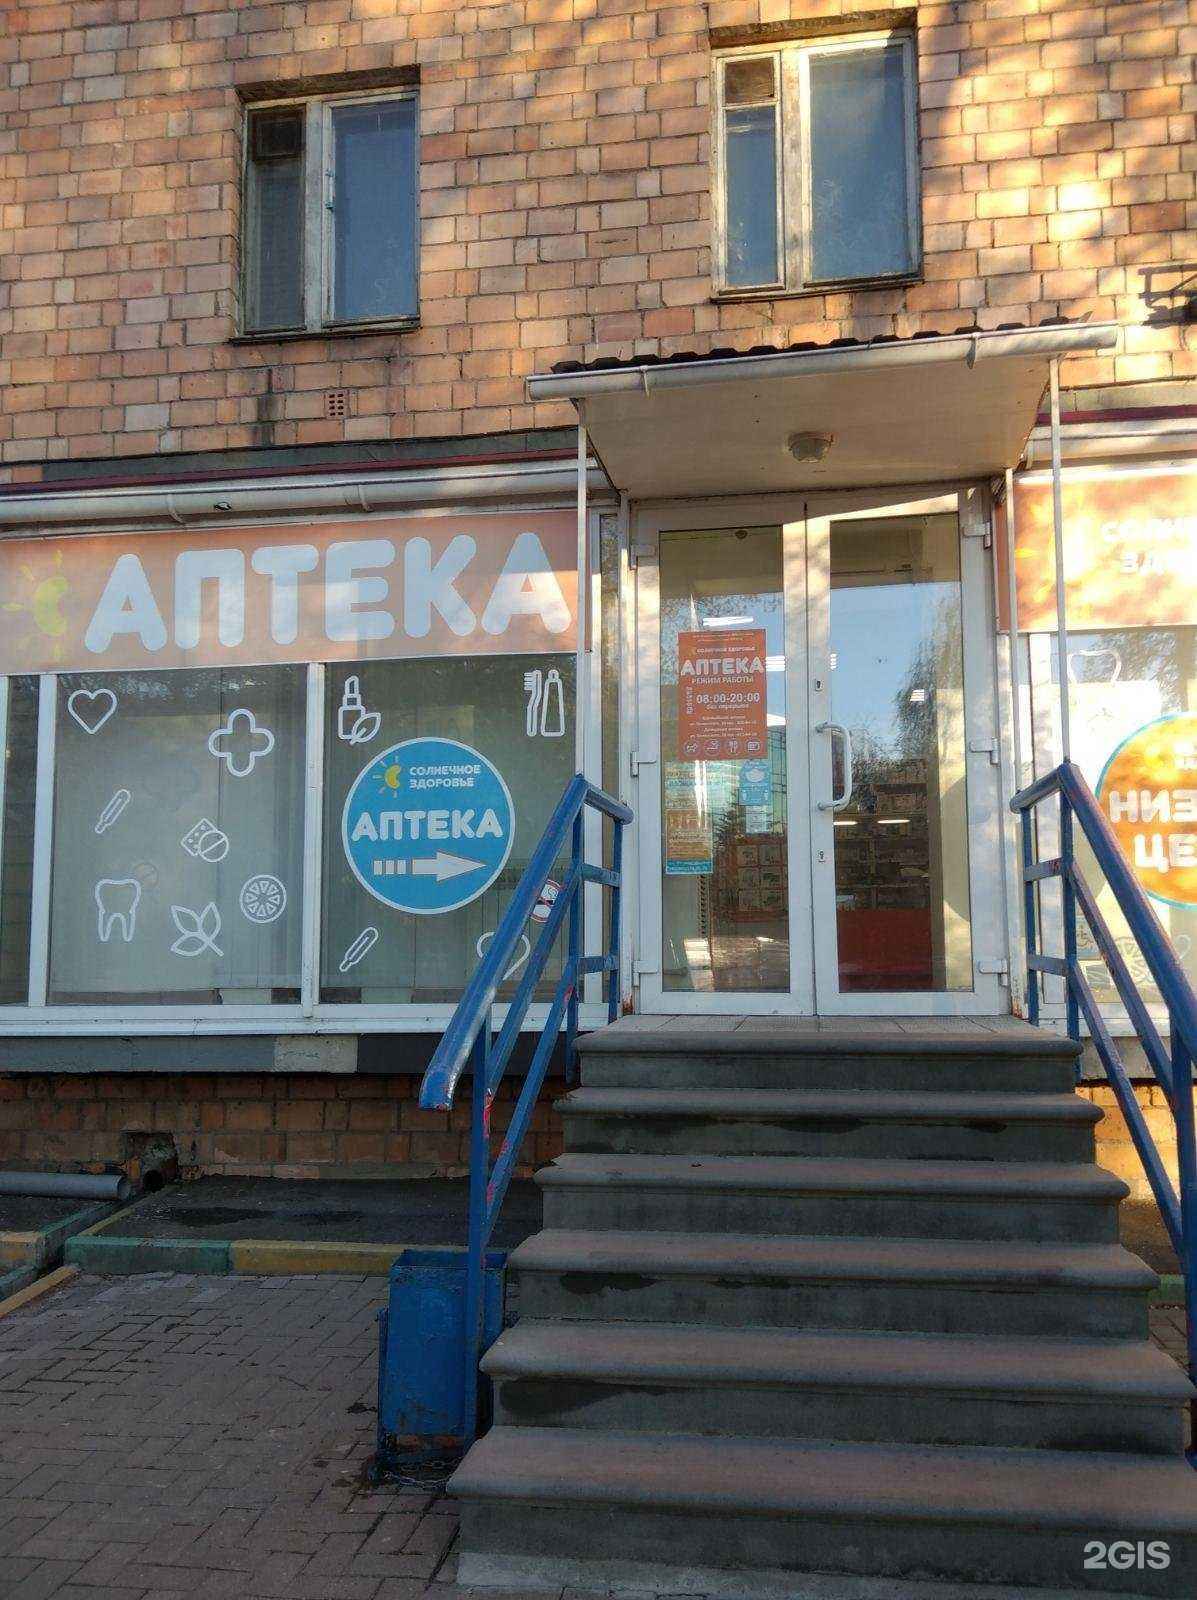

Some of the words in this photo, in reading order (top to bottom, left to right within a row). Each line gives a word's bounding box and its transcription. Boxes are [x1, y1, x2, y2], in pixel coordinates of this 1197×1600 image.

[85, 532, 571, 653] АПТЕКА
[680, 656, 764, 676] АПТЕКА
[722, 675, 754, 684] РАБОТЫ
[696, 692, 760, 705] 08:00-20:00
[409, 764, 481, 776] СОЛНЕЧНОЕ
[409, 777, 475, 790] ЗДОРОВЬЕ
[351, 808, 504, 842] АПТЕКА
